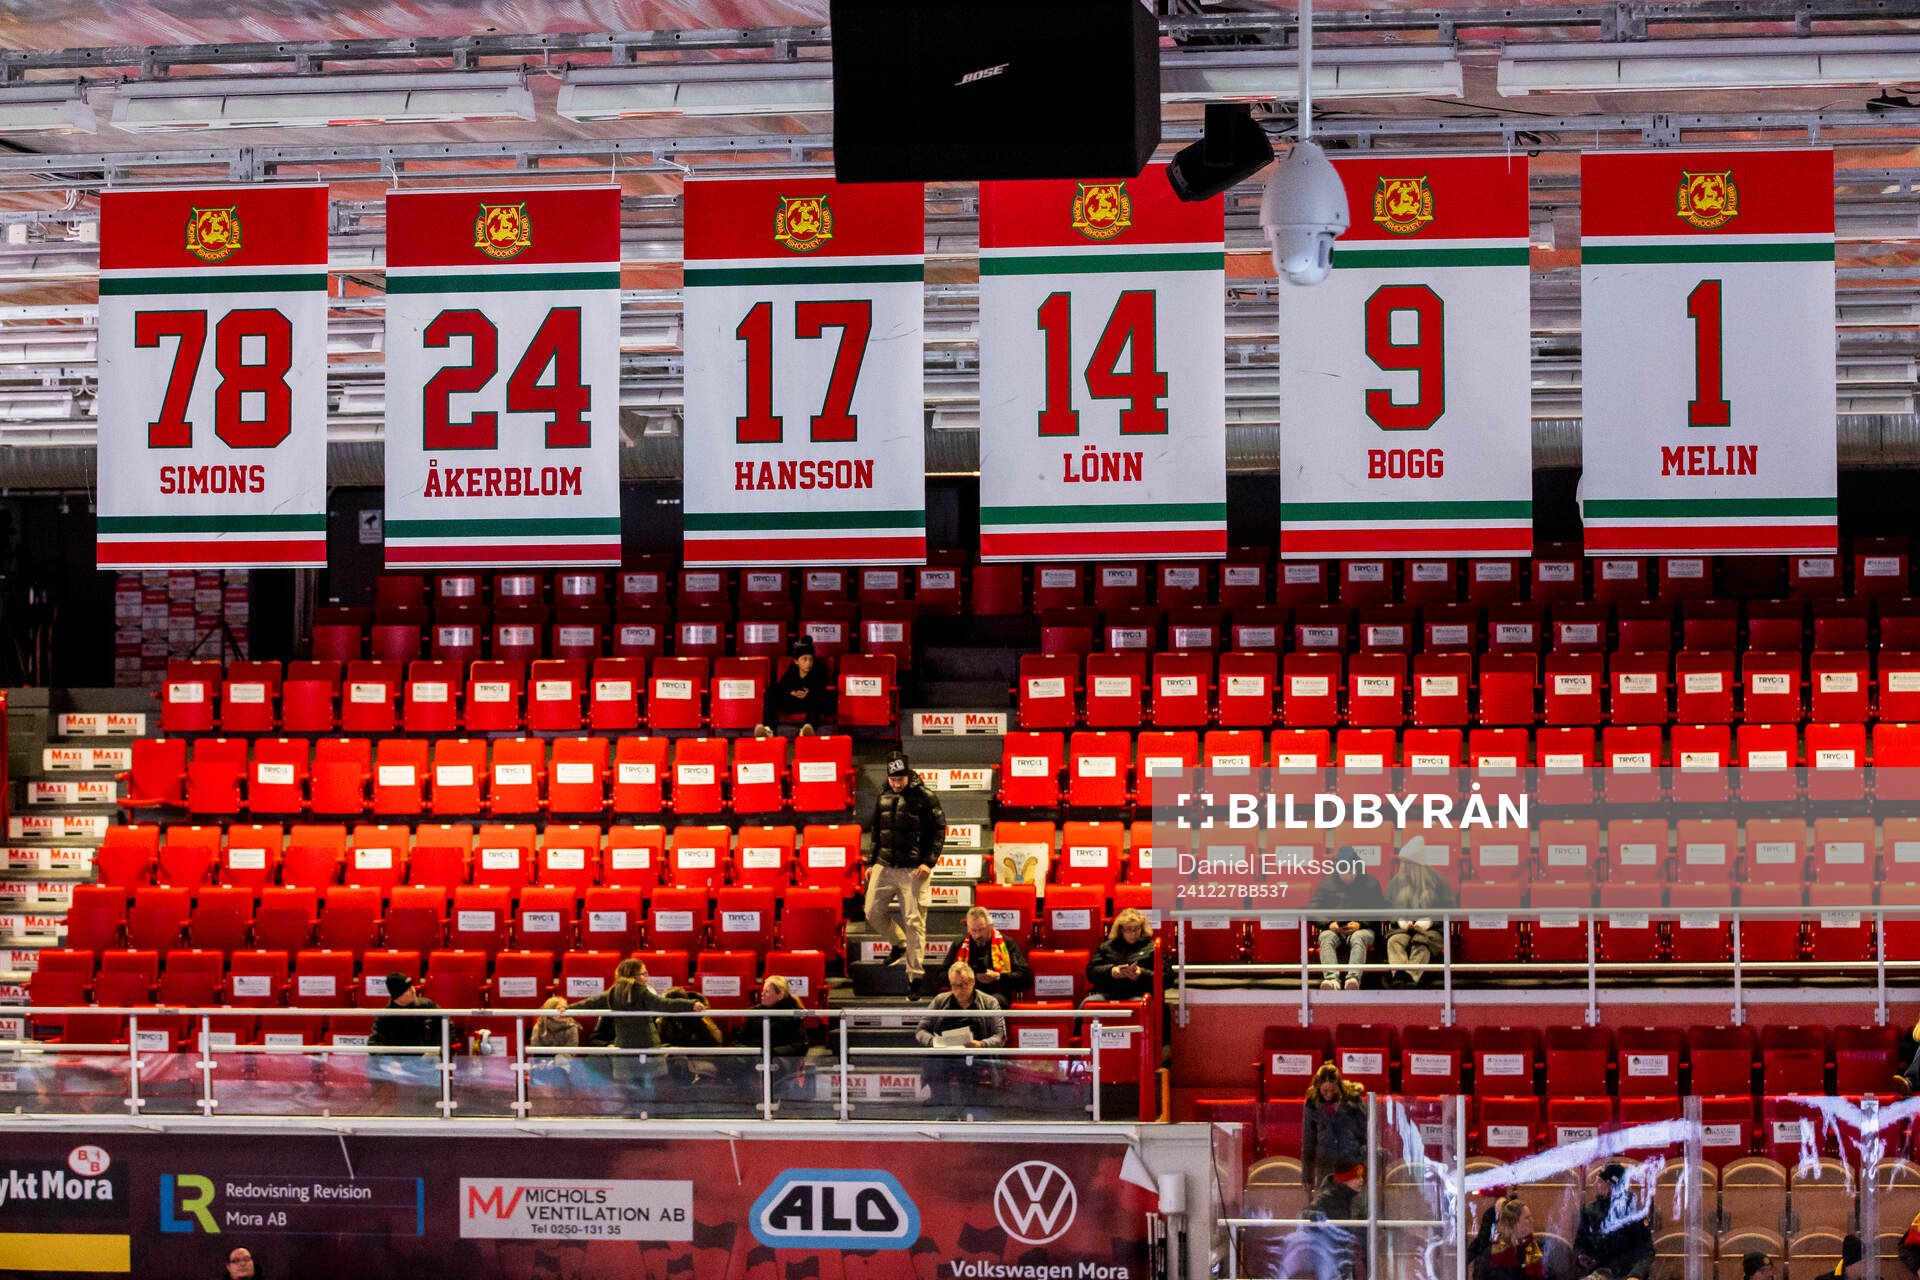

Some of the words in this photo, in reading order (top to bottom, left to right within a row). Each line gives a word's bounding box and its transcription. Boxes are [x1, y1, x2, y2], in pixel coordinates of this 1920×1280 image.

[955, 62, 1010, 86] BOSE
[1375, 194, 1383, 216] MORA
[1679, 188, 1687, 210] MORA
[1074, 201, 1082, 222] MORA
[476, 222, 484, 241] MORA
[776, 214, 784, 234] MORA
[1037, 289, 1169, 437] 14
[1364, 284, 1445, 432] 9
[1686, 279, 1731, 427] 1
[135, 308, 292, 449] 78
[423, 306, 592, 451] 24
[735, 300, 872, 443] 17
[1063, 445, 1144, 483] LÖNN
[1368, 448, 1445, 479] BOGG
[1661, 446, 1758, 476] MELIN
[160, 465, 265, 494] SIMONS
[423, 459, 583, 497] ÅKERBLOM
[734, 460, 874, 490] HANSSON
[66, 715, 96, 725] MAXI
[107, 715, 137, 725] MAXI
[921, 715, 954, 725] MAXI
[965, 715, 998, 725] MAXI
[51, 750, 82, 760] MAXI
[93, 750, 124, 760] MAXI
[950, 770, 983, 781] MAXI
[36, 783, 67, 793] MAXI
[78, 783, 109, 793] MAXI
[22, 816, 53, 827] MAXI
[64, 816, 95, 827] MAXI
[8, 849, 39, 860] MAXI
[50, 849, 81, 860] MAXI
[38, 882, 68, 892] MAXI
[931, 887, 958, 896] MAXI
[880, 1075, 915, 1087] MAXI
[42, 1170, 113, 1200] Mora
[226, 1183, 310, 1202] Redovisning
[313, 1184, 371, 1199] Revision
[160, 1174, 221, 1234] LR
[525, 1189, 607, 1204] MICHOLS
[226, 1212, 263, 1226] Mora
[267, 1212, 287, 1226] AB
[527, 1206, 650, 1221] VENTILATION
[659, 1208, 685, 1222] AB
[769, 1185, 899, 1232] ALO
[531, 1224, 547, 1234] Tel
[550, 1224, 603, 1235] 0250-131
[607, 1226, 621, 1235] 35
[951, 1260, 1074, 1280] Volkswagen
[1078, 1261, 1129, 1279] Mora
